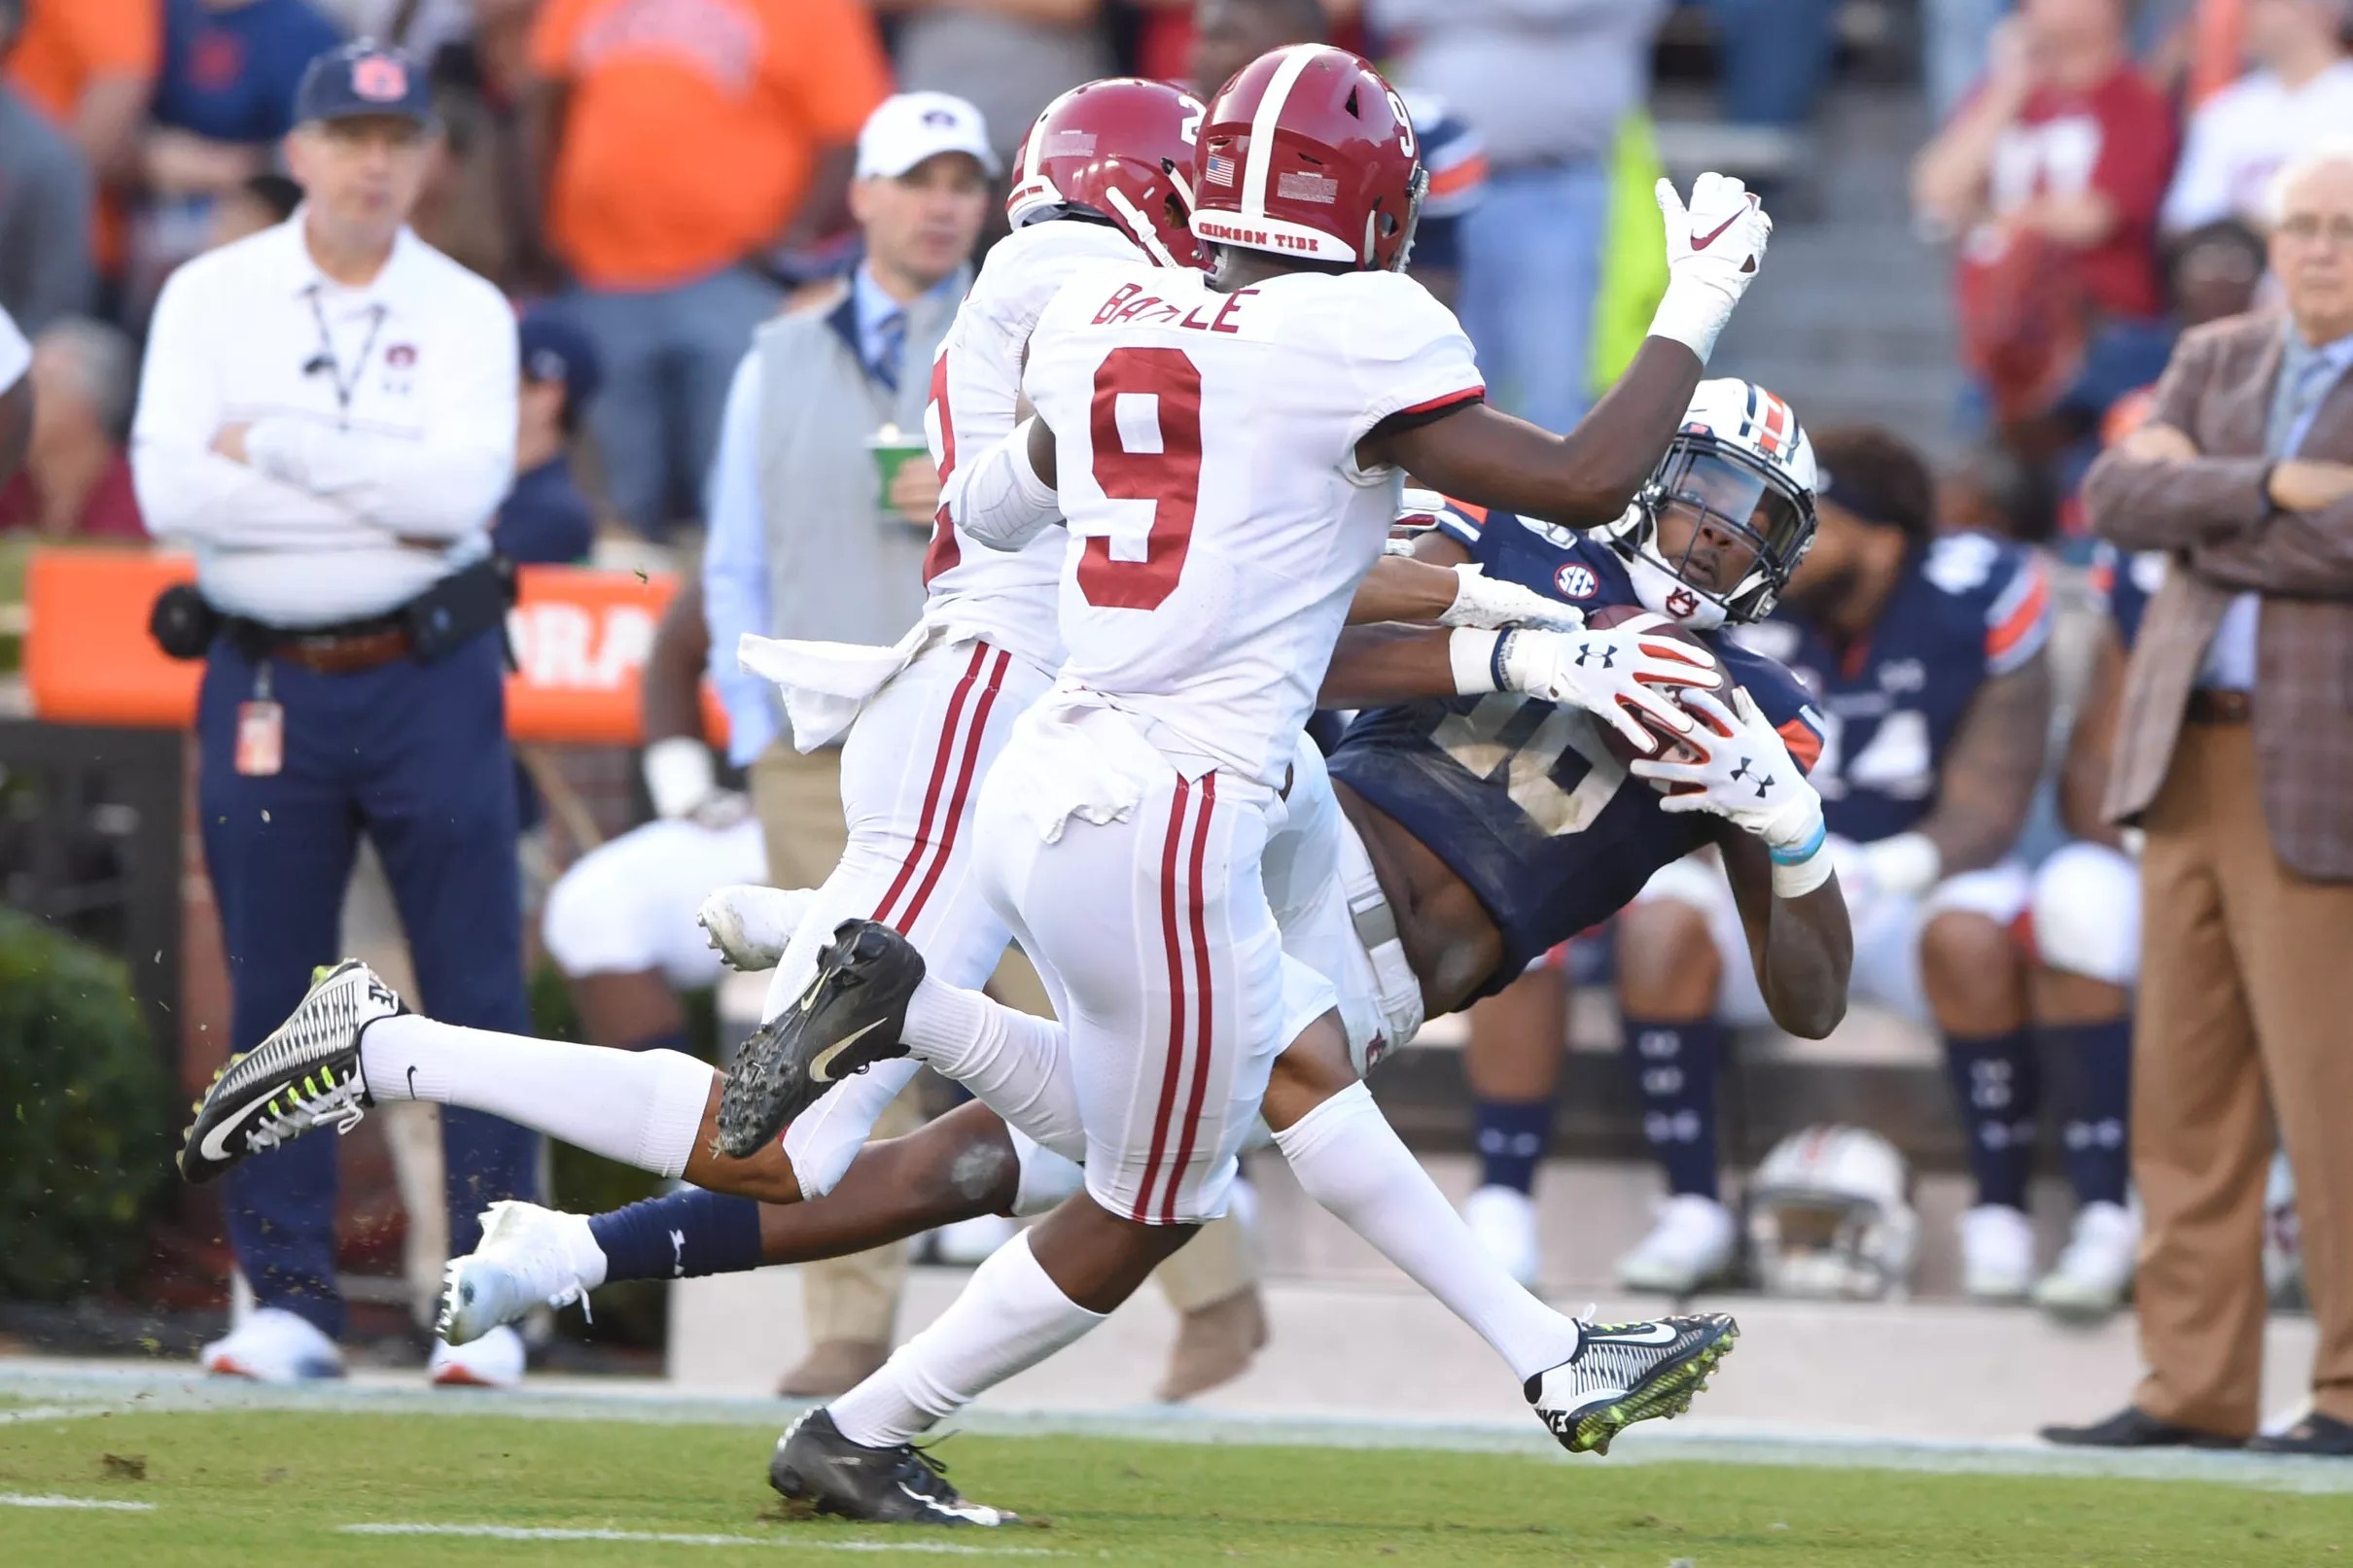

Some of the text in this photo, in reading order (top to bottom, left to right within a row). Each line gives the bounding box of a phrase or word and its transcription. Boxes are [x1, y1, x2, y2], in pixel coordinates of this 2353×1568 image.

[1387, 91, 1415, 158] 9
[1198, 222, 1318, 252] CRIMSON TIDE
[1076, 346, 1203, 611] 9
[1558, 566, 1596, 598] SEC
